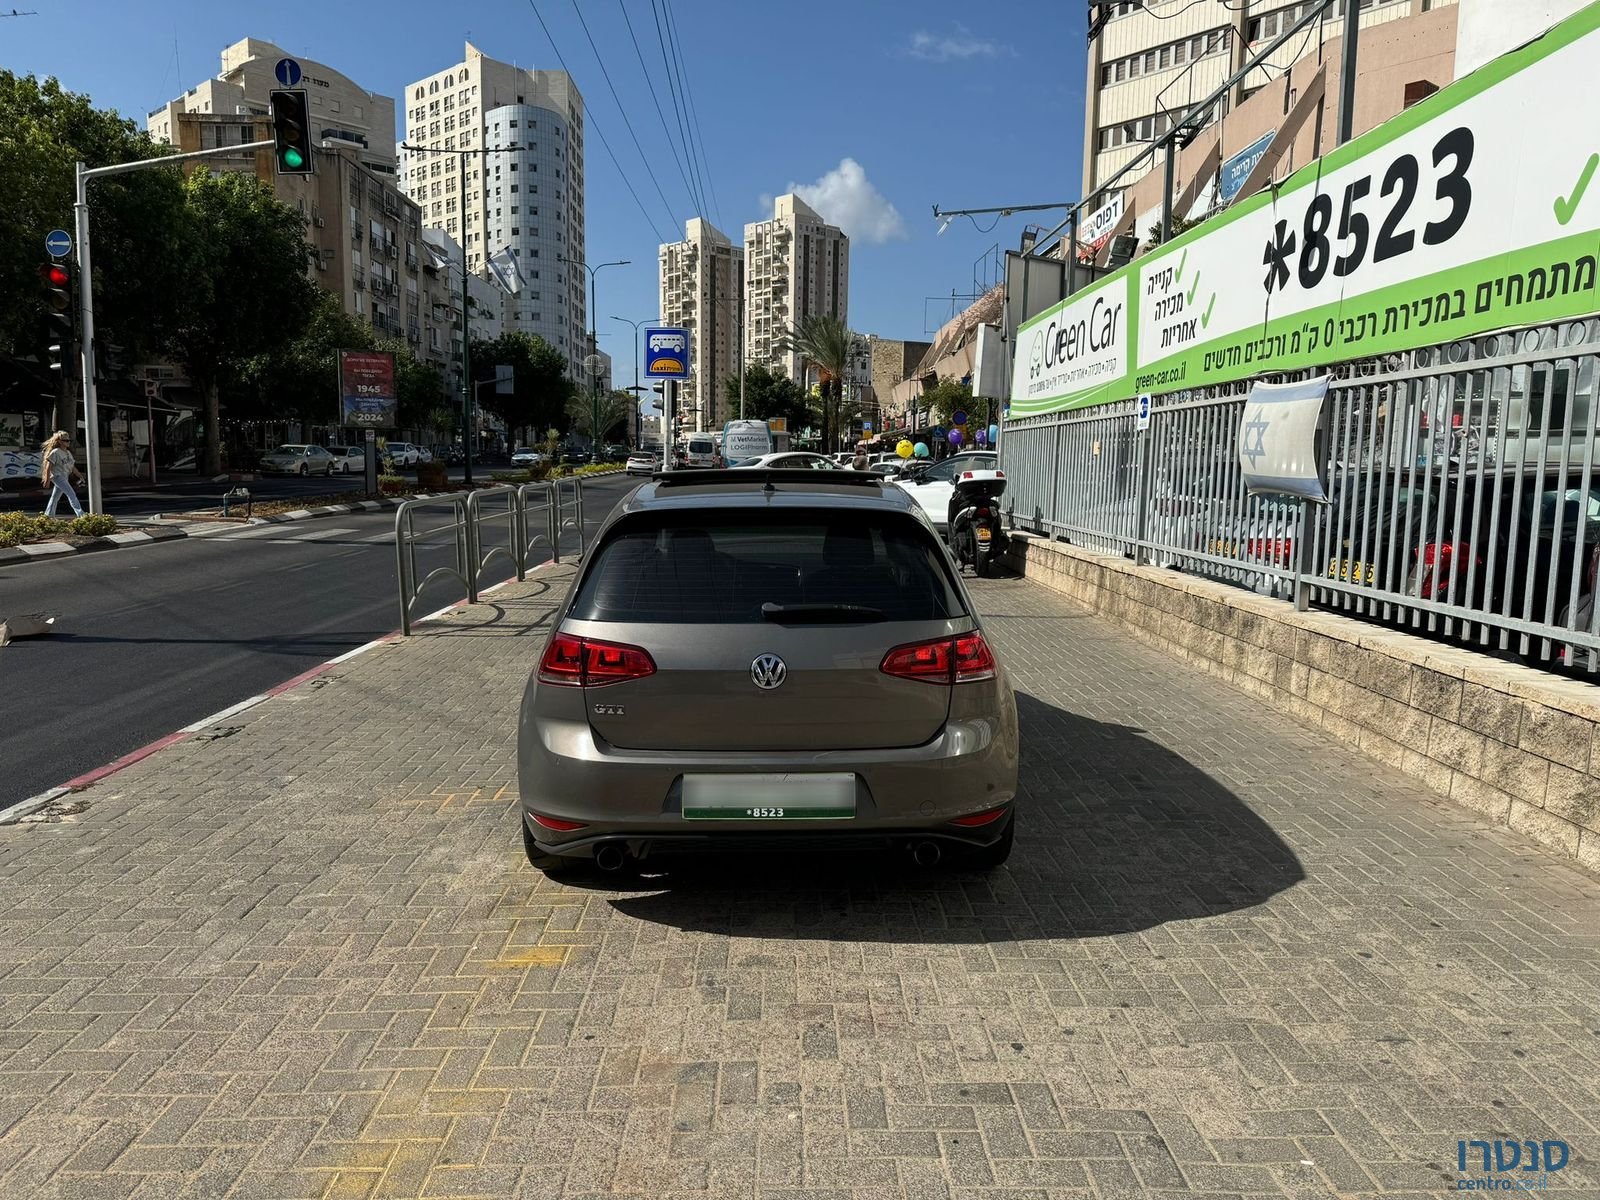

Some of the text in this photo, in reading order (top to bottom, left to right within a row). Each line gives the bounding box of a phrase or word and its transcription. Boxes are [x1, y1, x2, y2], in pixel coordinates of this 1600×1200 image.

[1096, 200, 1118, 230] דפוס
[1147, 266, 1173, 296] קנייה
[1474, 255, 1596, 314] מתמחים
[1154, 292, 1184, 321] מכירה
[1382, 289, 1466, 335] במכירת
[1045, 296, 1122, 369] Green Car
[1160, 317, 1197, 348] אחריות
[1324, 317, 1334, 348] 0
[1339, 312, 1377, 344] רכבי
[1203, 345, 1241, 372] חדשים
[1244, 333, 1286, 363] ורכבים
[357, 384, 381, 393] 1945
[1135, 361, 1187, 393] green-car.co.il
[357, 413, 384, 422] 2024
[751, 653, 787, 689] VW
[594, 703, 625, 715] GTI
